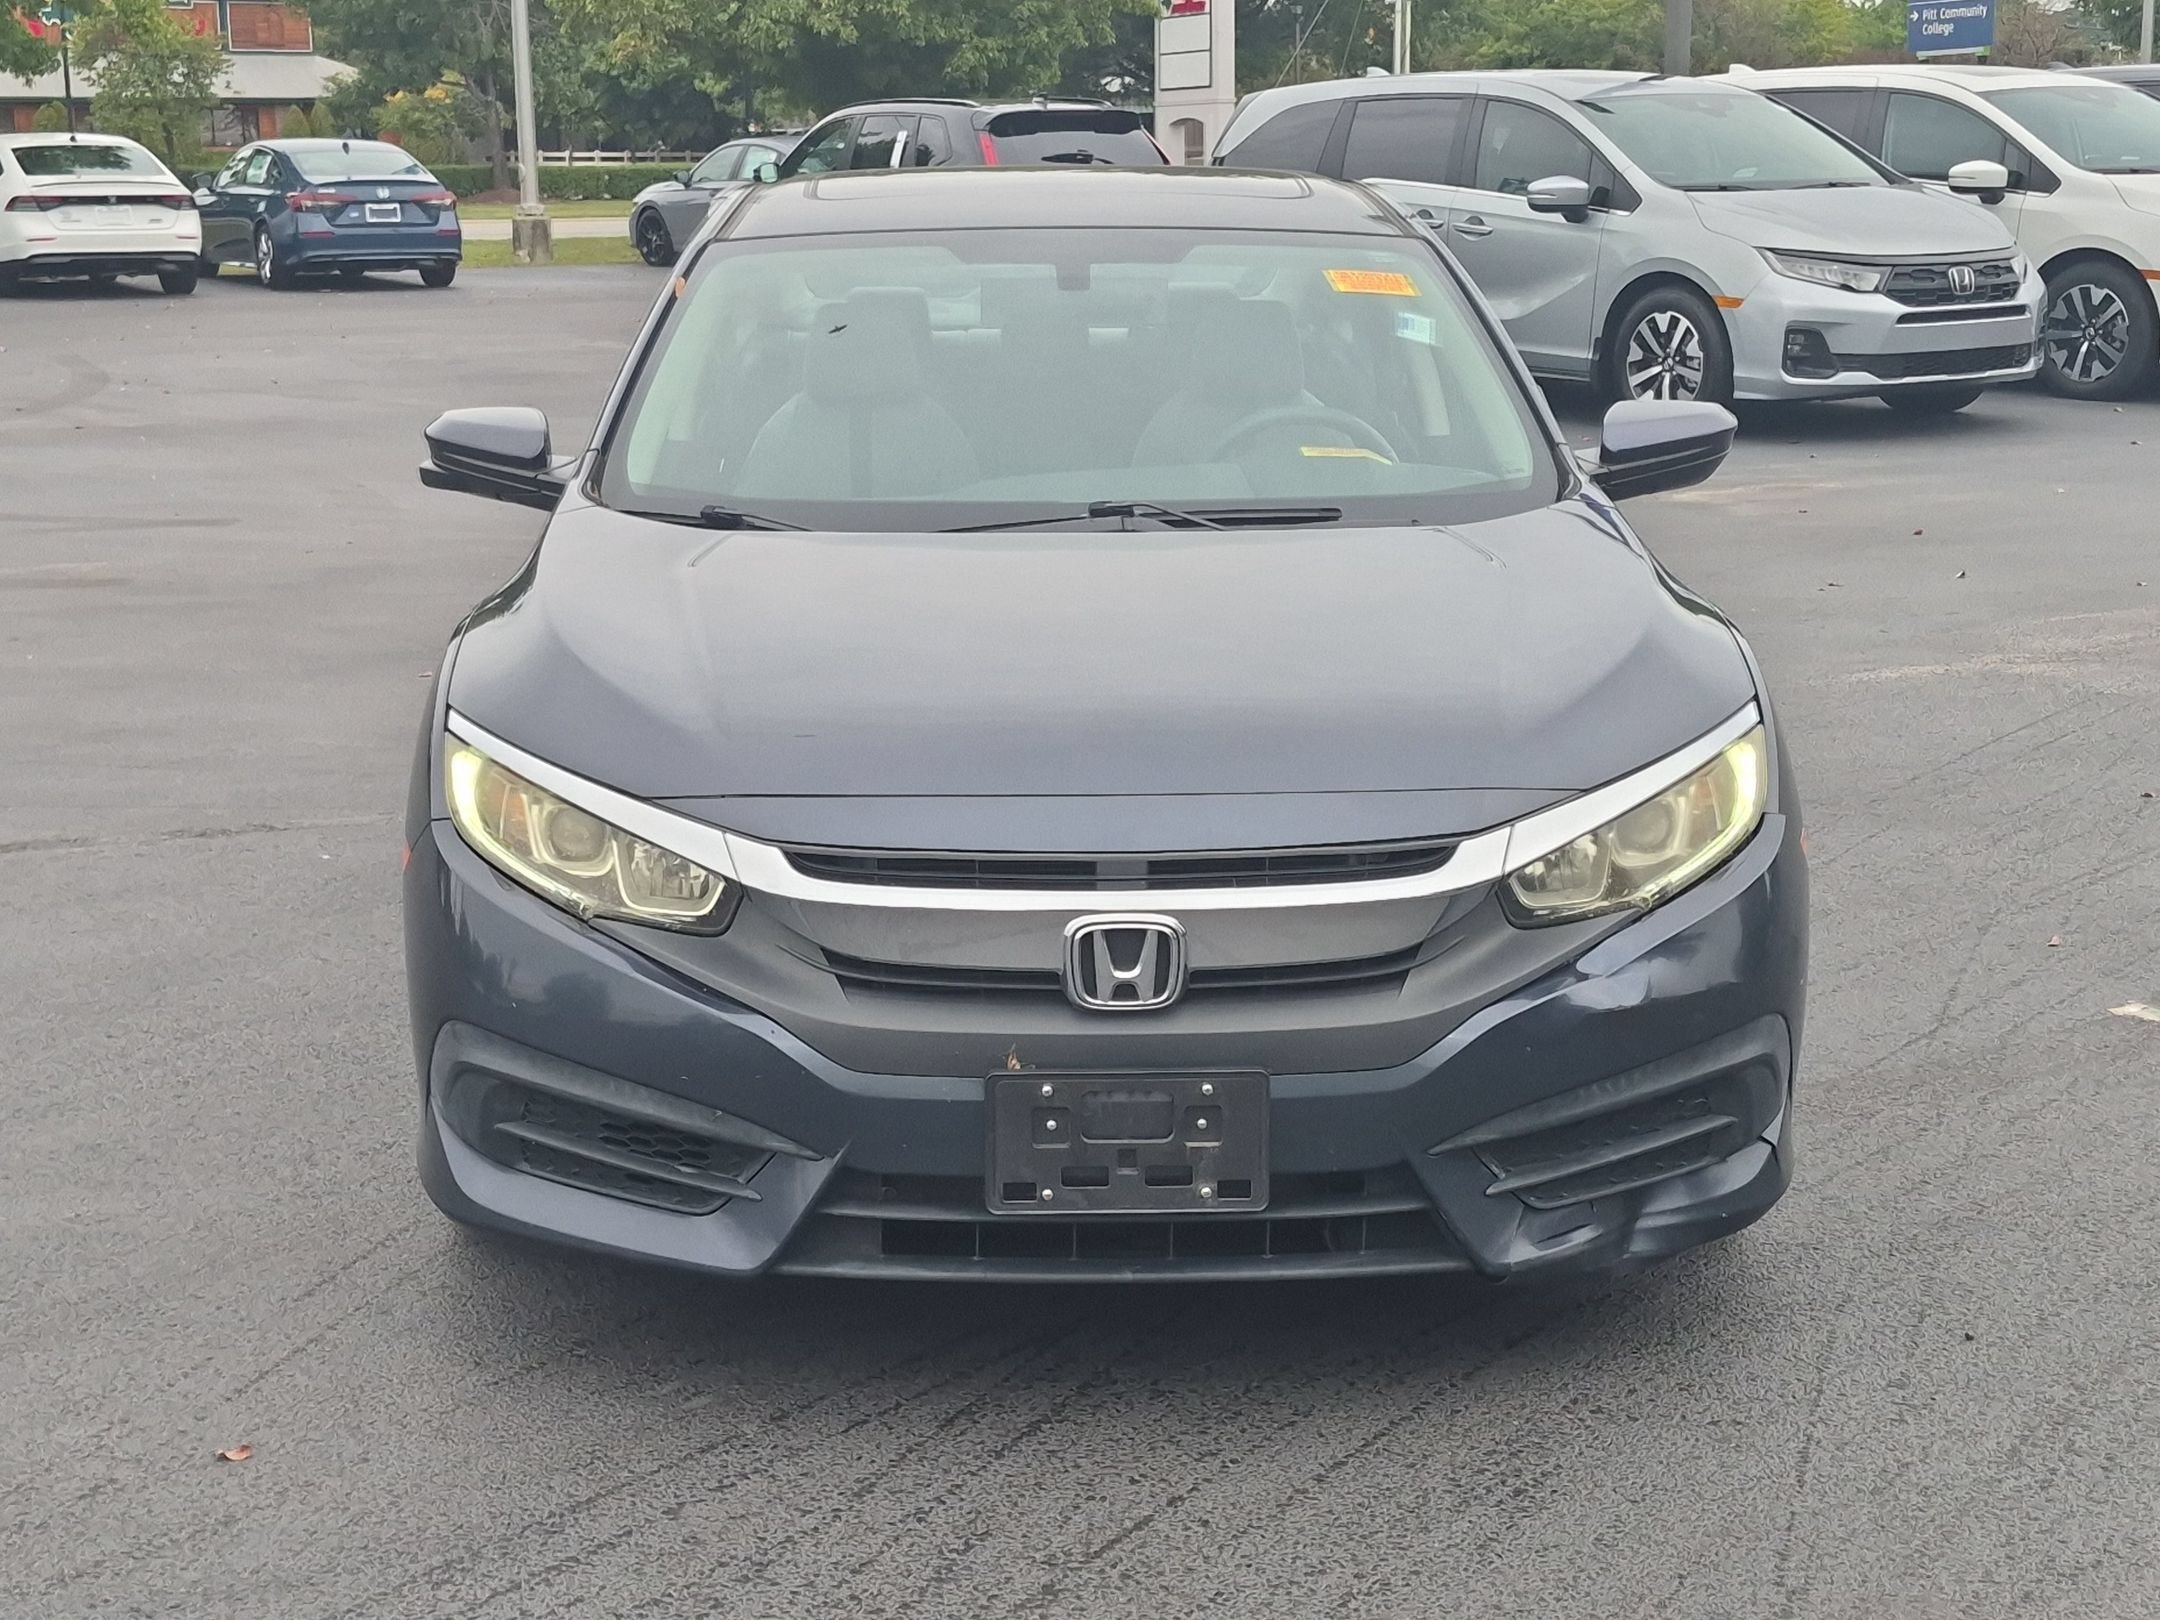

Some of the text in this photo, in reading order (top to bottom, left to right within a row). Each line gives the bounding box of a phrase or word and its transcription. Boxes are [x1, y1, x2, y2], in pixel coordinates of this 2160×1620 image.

[1922, 4, 1988, 21] Pitt Community
[1922, 22, 1954, 36] College
